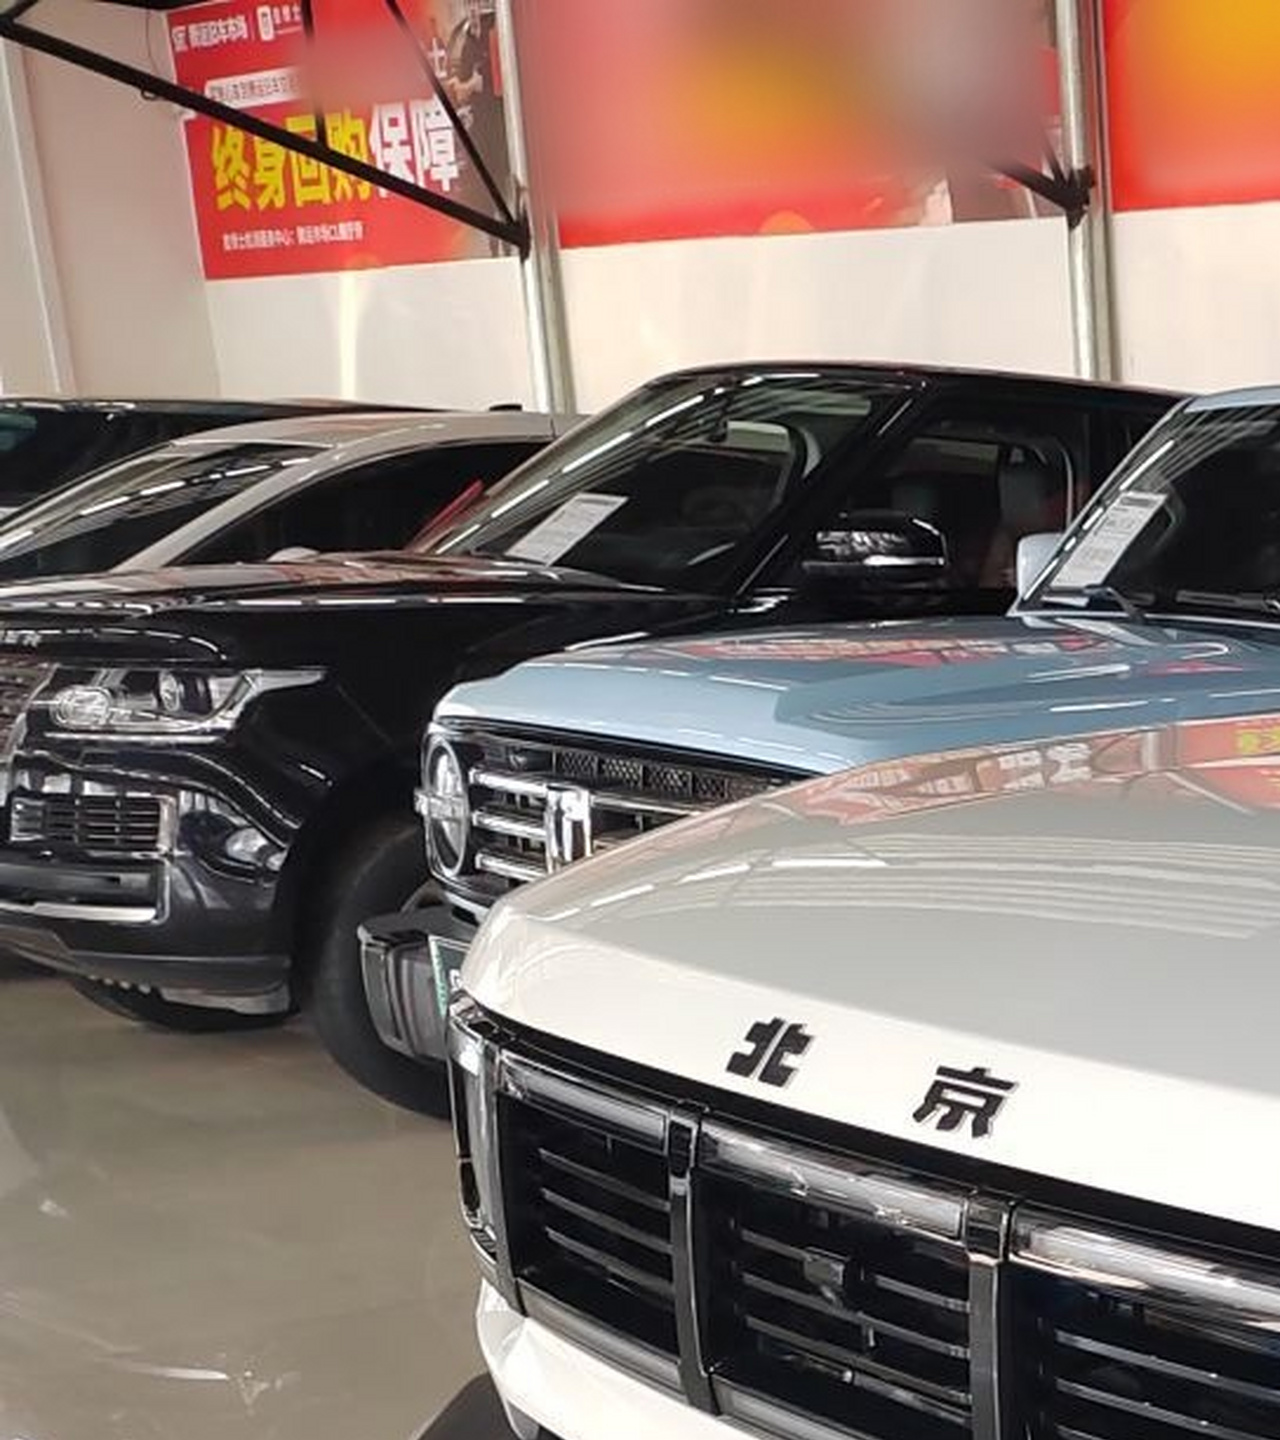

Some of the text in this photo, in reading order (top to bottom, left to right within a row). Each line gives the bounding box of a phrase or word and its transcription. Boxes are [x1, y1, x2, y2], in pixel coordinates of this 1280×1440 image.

[211, 98, 460, 211] 终身回购保障
[726, 1016, 1017, 1138] 北京
